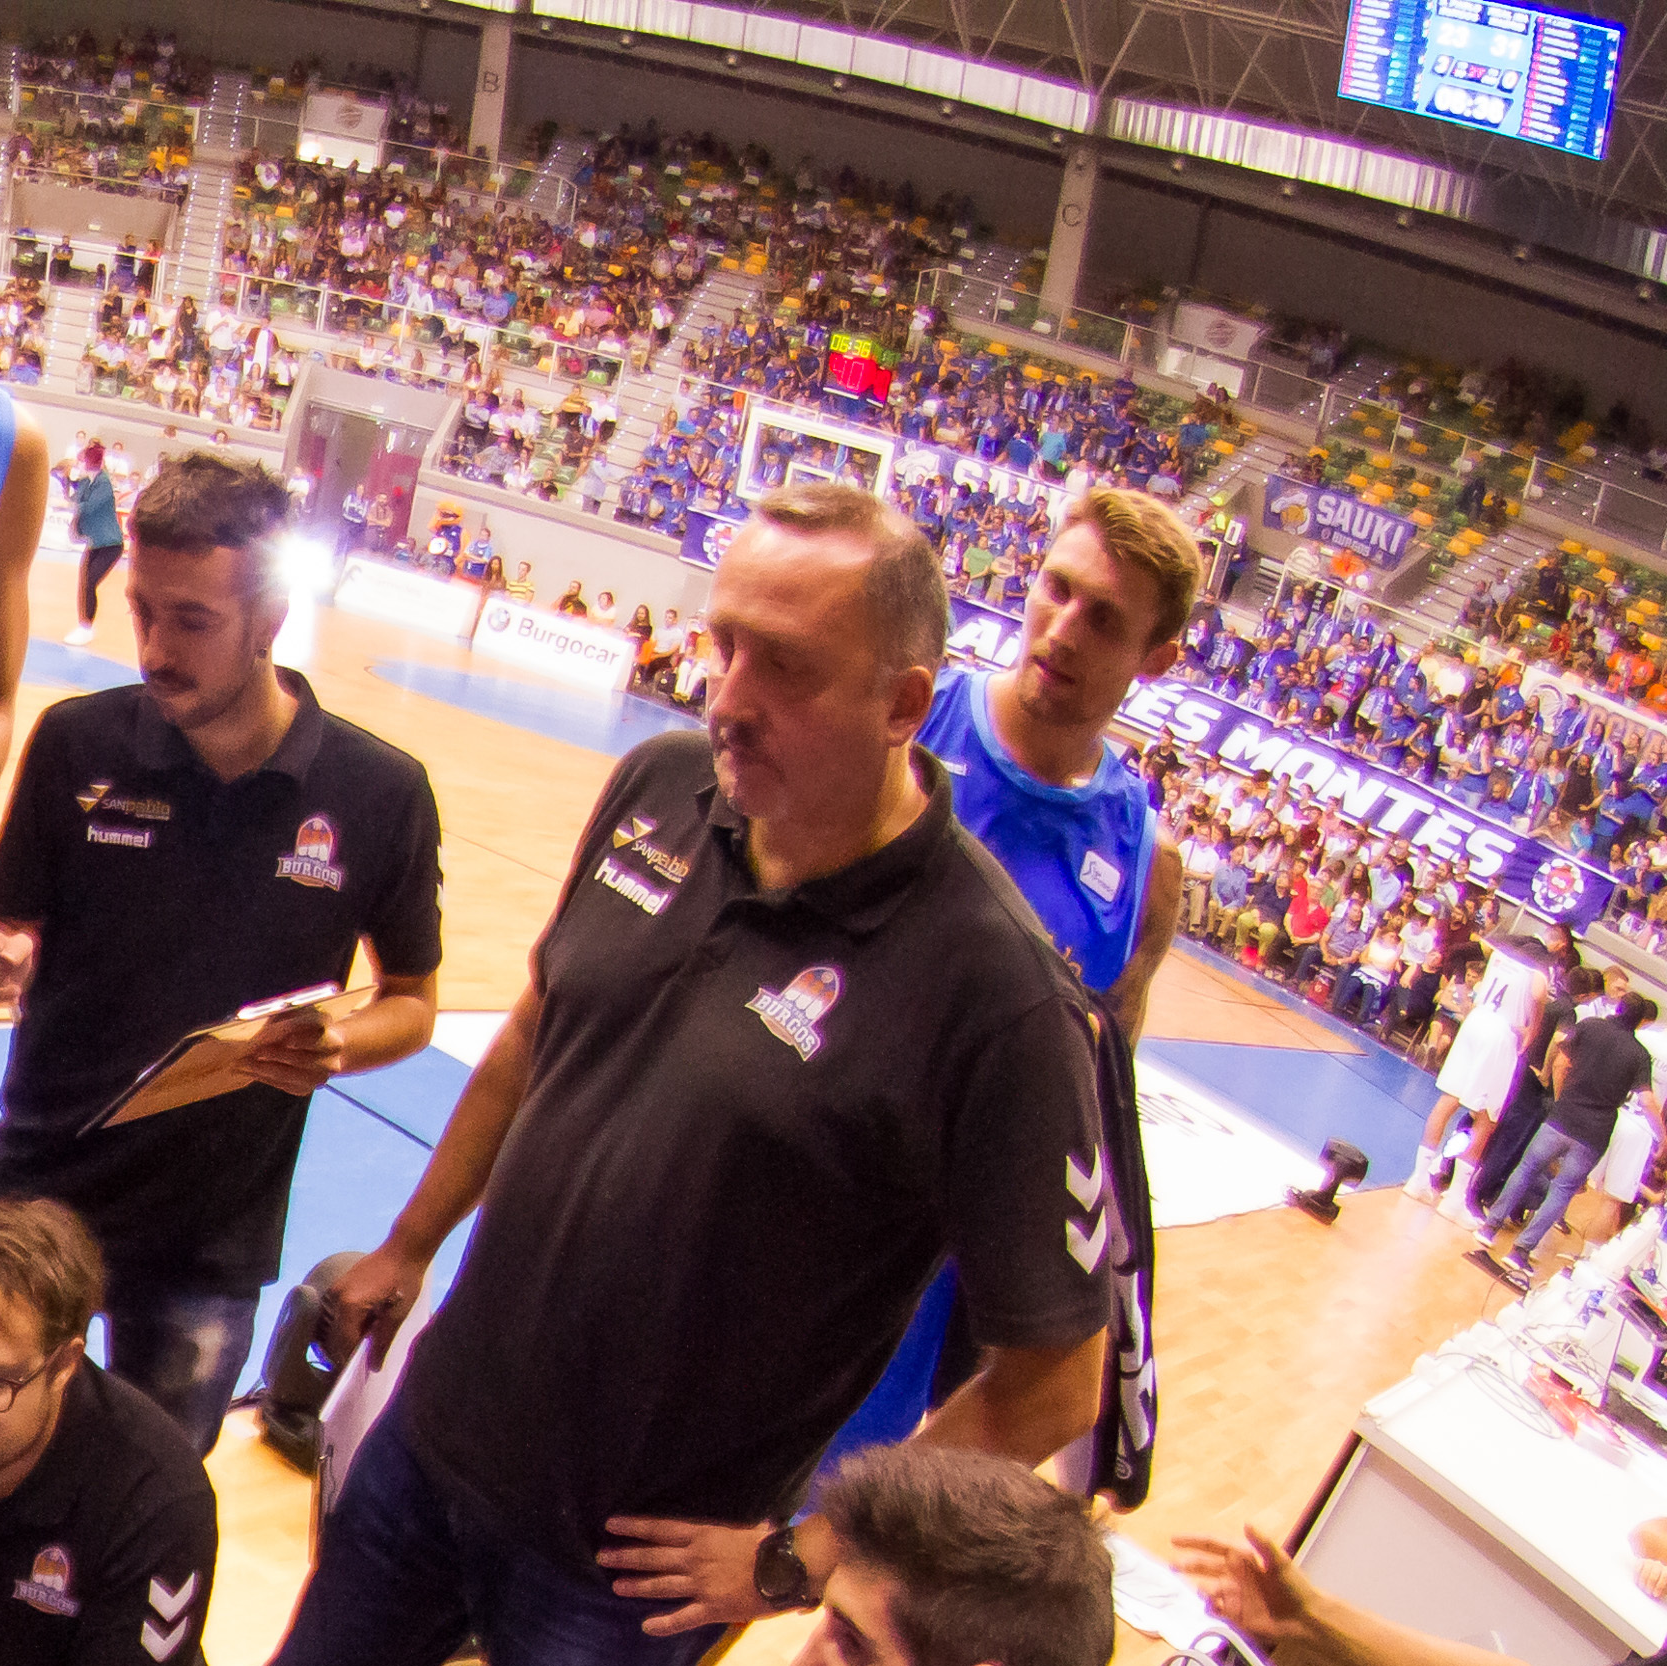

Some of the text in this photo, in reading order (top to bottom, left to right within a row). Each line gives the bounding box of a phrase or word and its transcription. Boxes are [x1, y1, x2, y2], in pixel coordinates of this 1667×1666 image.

[482, 72, 499, 93] B
[1061, 204, 1081, 226] C
[830, 334, 871, 358] 06:36
[1316, 495, 1405, 556] SAUKI
[517, 616, 621, 668] Burgocar
[1218, 720, 1517, 878] MONTES
[87, 825, 150, 849] hummel
[593, 858, 669, 917] hummel
[754, 994, 817, 1054] BURGOS
